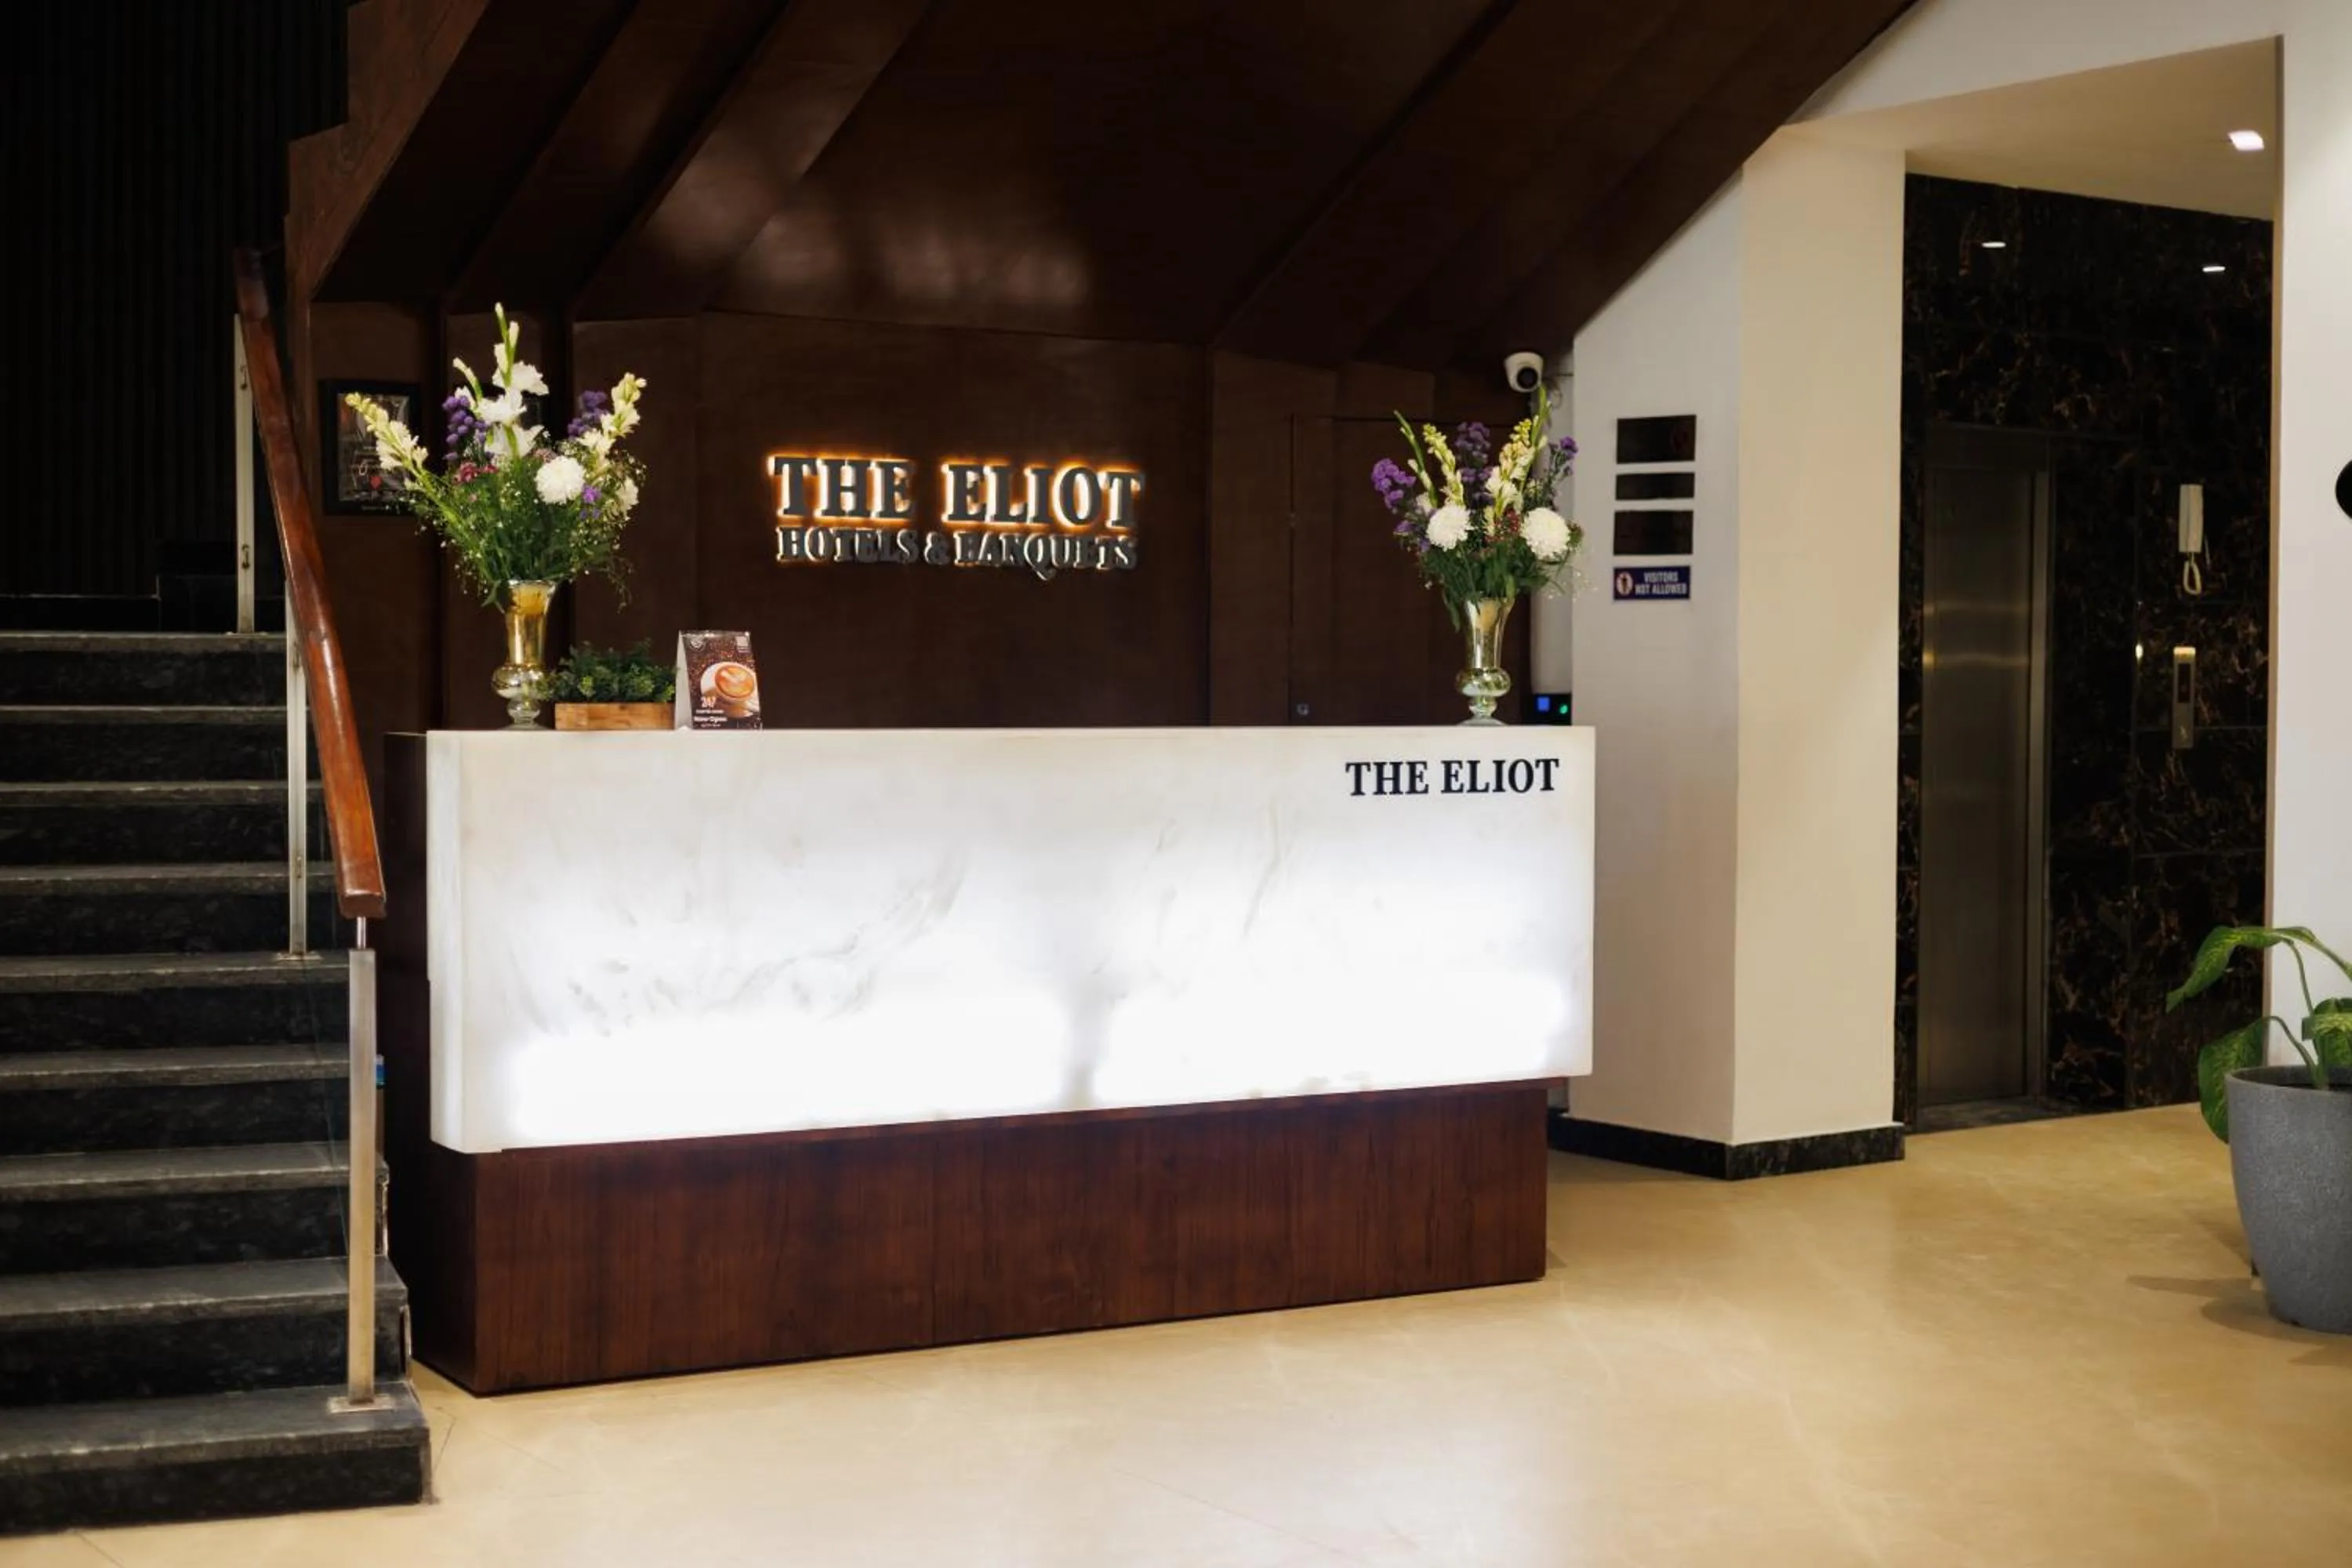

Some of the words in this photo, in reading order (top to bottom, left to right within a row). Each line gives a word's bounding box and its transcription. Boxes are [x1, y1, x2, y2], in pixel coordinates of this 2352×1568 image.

[768, 456, 915, 520] THE
[942, 462, 1145, 530] ELIOT
[776, 526, 919, 564] HOTELS
[924, 531, 949, 565] &
[954, 531, 1138, 581] BANQUETS
[1635, 584, 1650, 595] NOT
[1651, 583, 1687, 594] ALLOWED
[1644, 572, 1679, 583] VISITORS
[1345, 760, 1429, 797] THE
[1440, 758, 1559, 793] ELIOT
